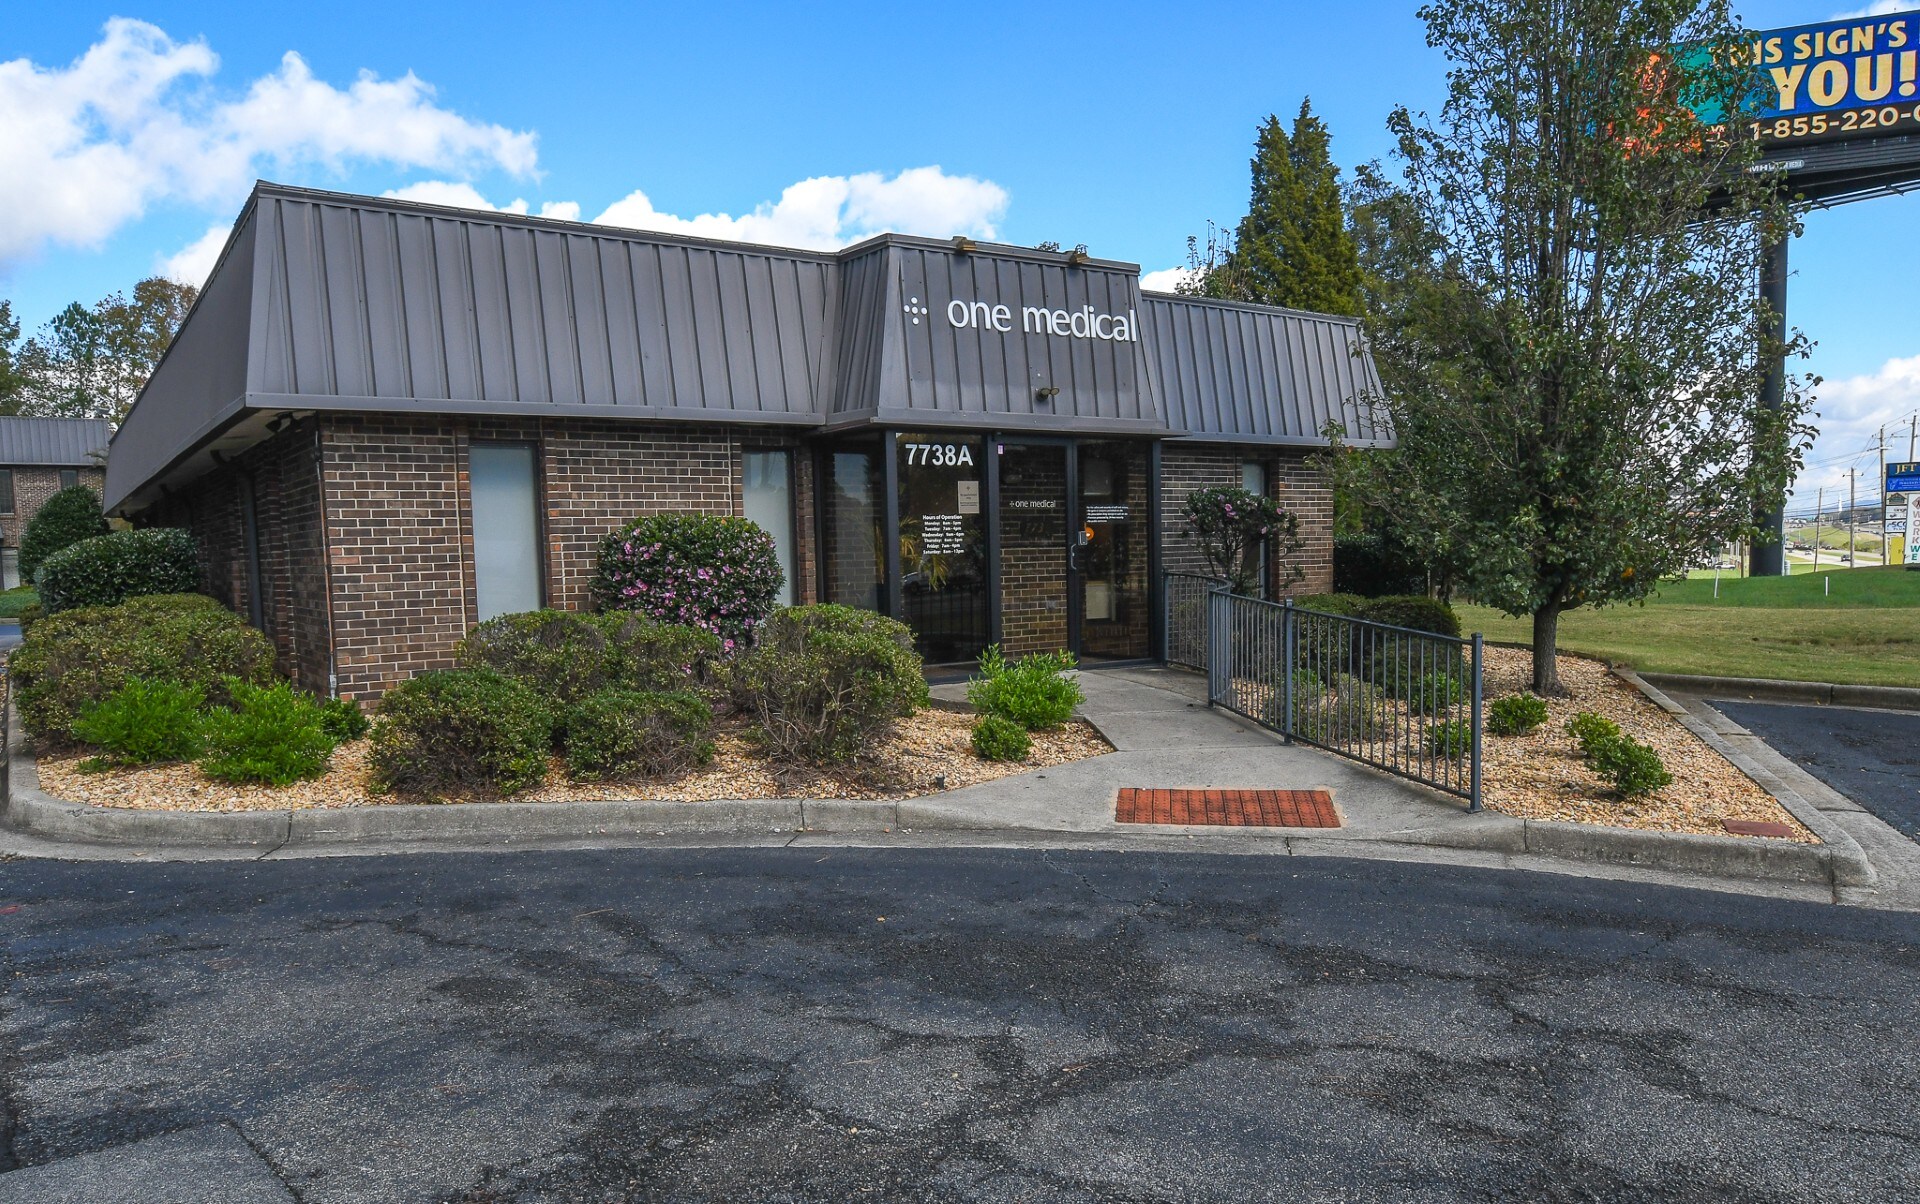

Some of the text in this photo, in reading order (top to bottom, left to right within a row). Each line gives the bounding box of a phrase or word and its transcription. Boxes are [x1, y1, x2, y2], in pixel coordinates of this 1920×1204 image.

[1793, 20, 1907, 60] SIGN'S
[1770, 50, 1916, 111] YOU!
[947, 299, 1137, 342] one medical
[905, 444, 974, 466] 7738A
[1895, 464, 1917, 475] JFT
[1030, 500, 1056, 508] medical
